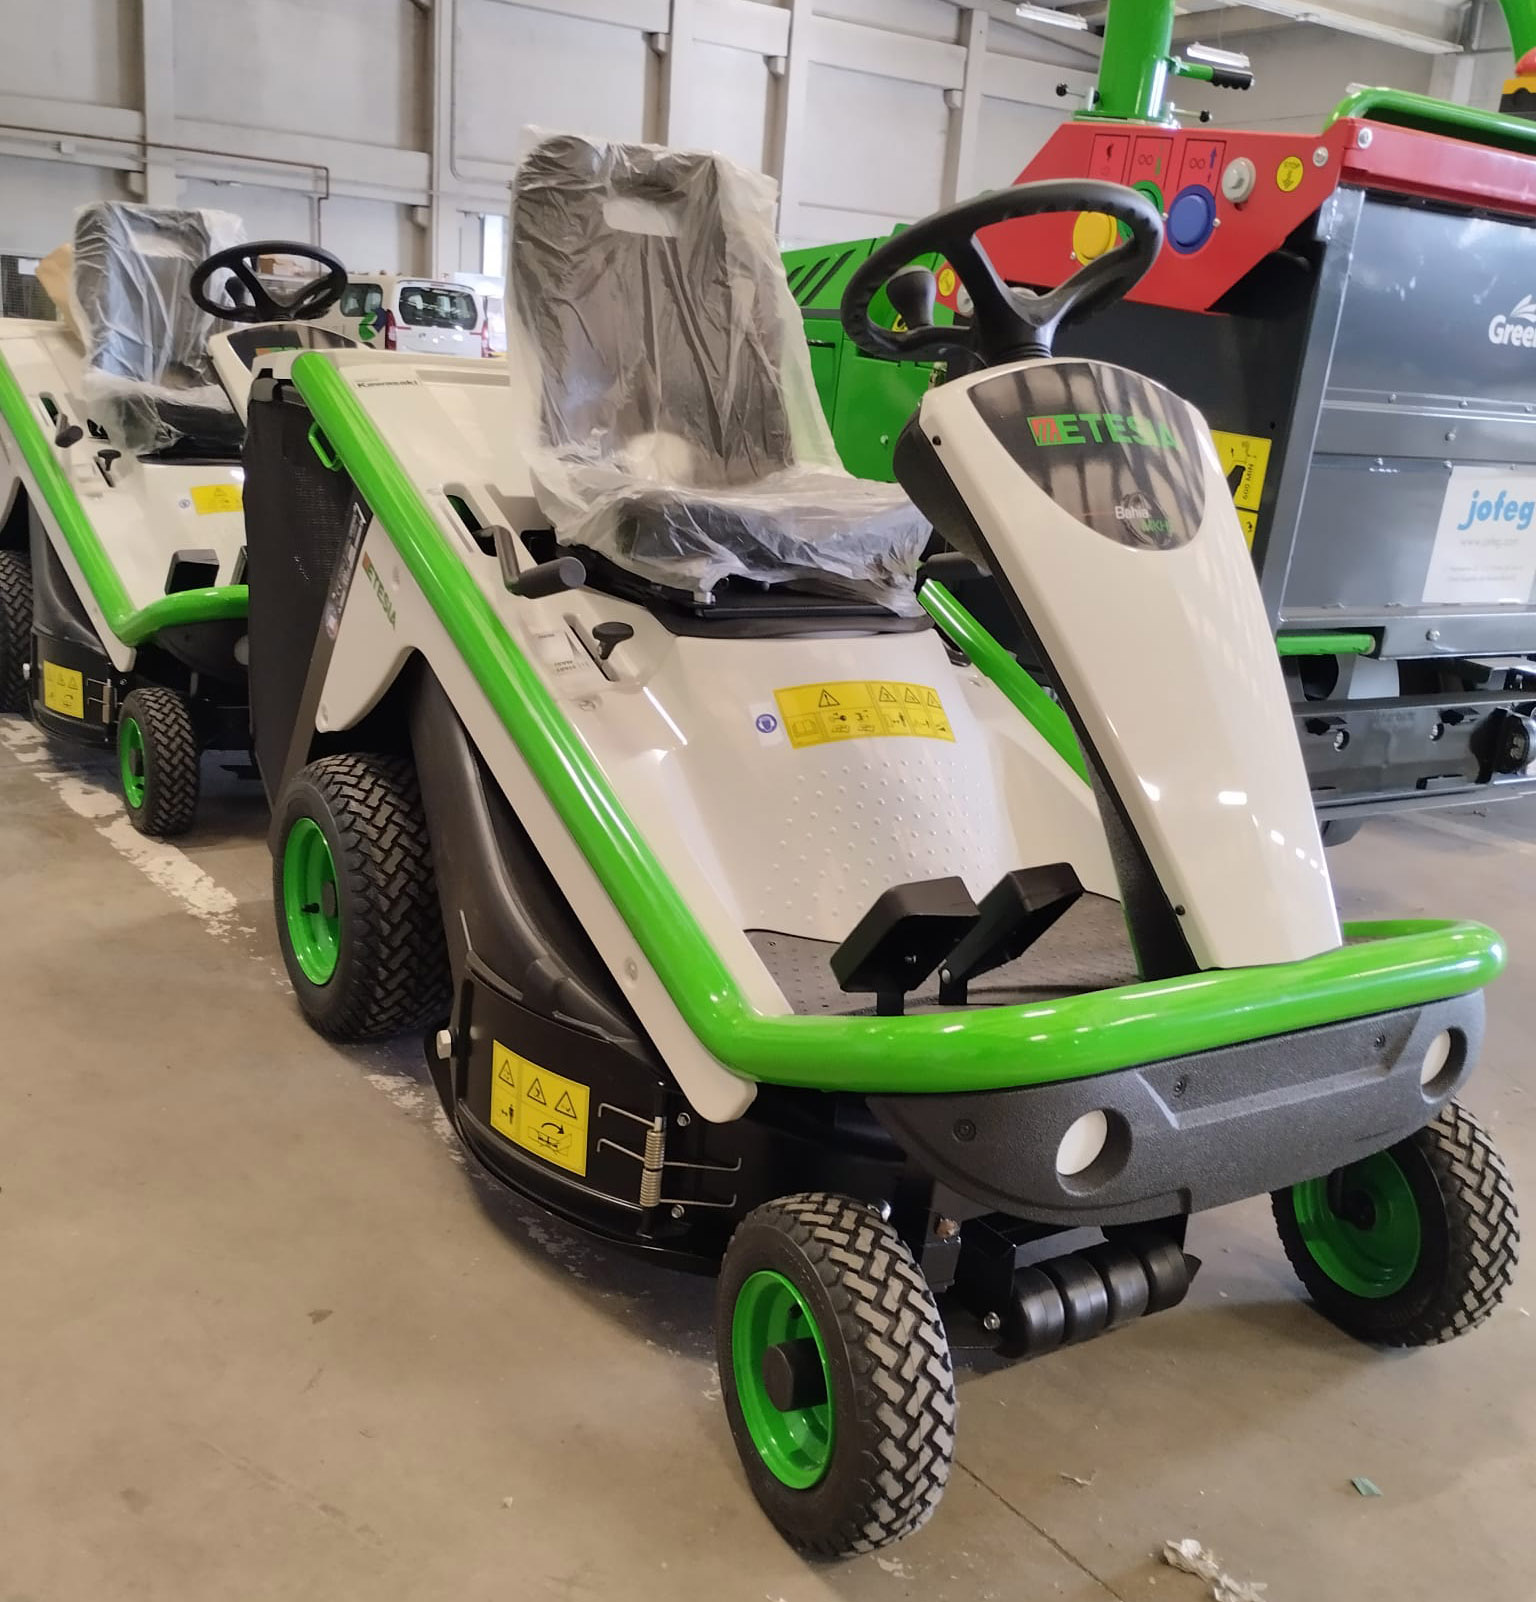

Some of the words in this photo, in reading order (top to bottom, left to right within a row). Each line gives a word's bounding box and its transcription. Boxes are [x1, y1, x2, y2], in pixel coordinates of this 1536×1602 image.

[1488, 314, 1536, 348] Gree
[1457, 489, 1536, 531] jofeg
[365, 562, 396, 631] ETESIA
